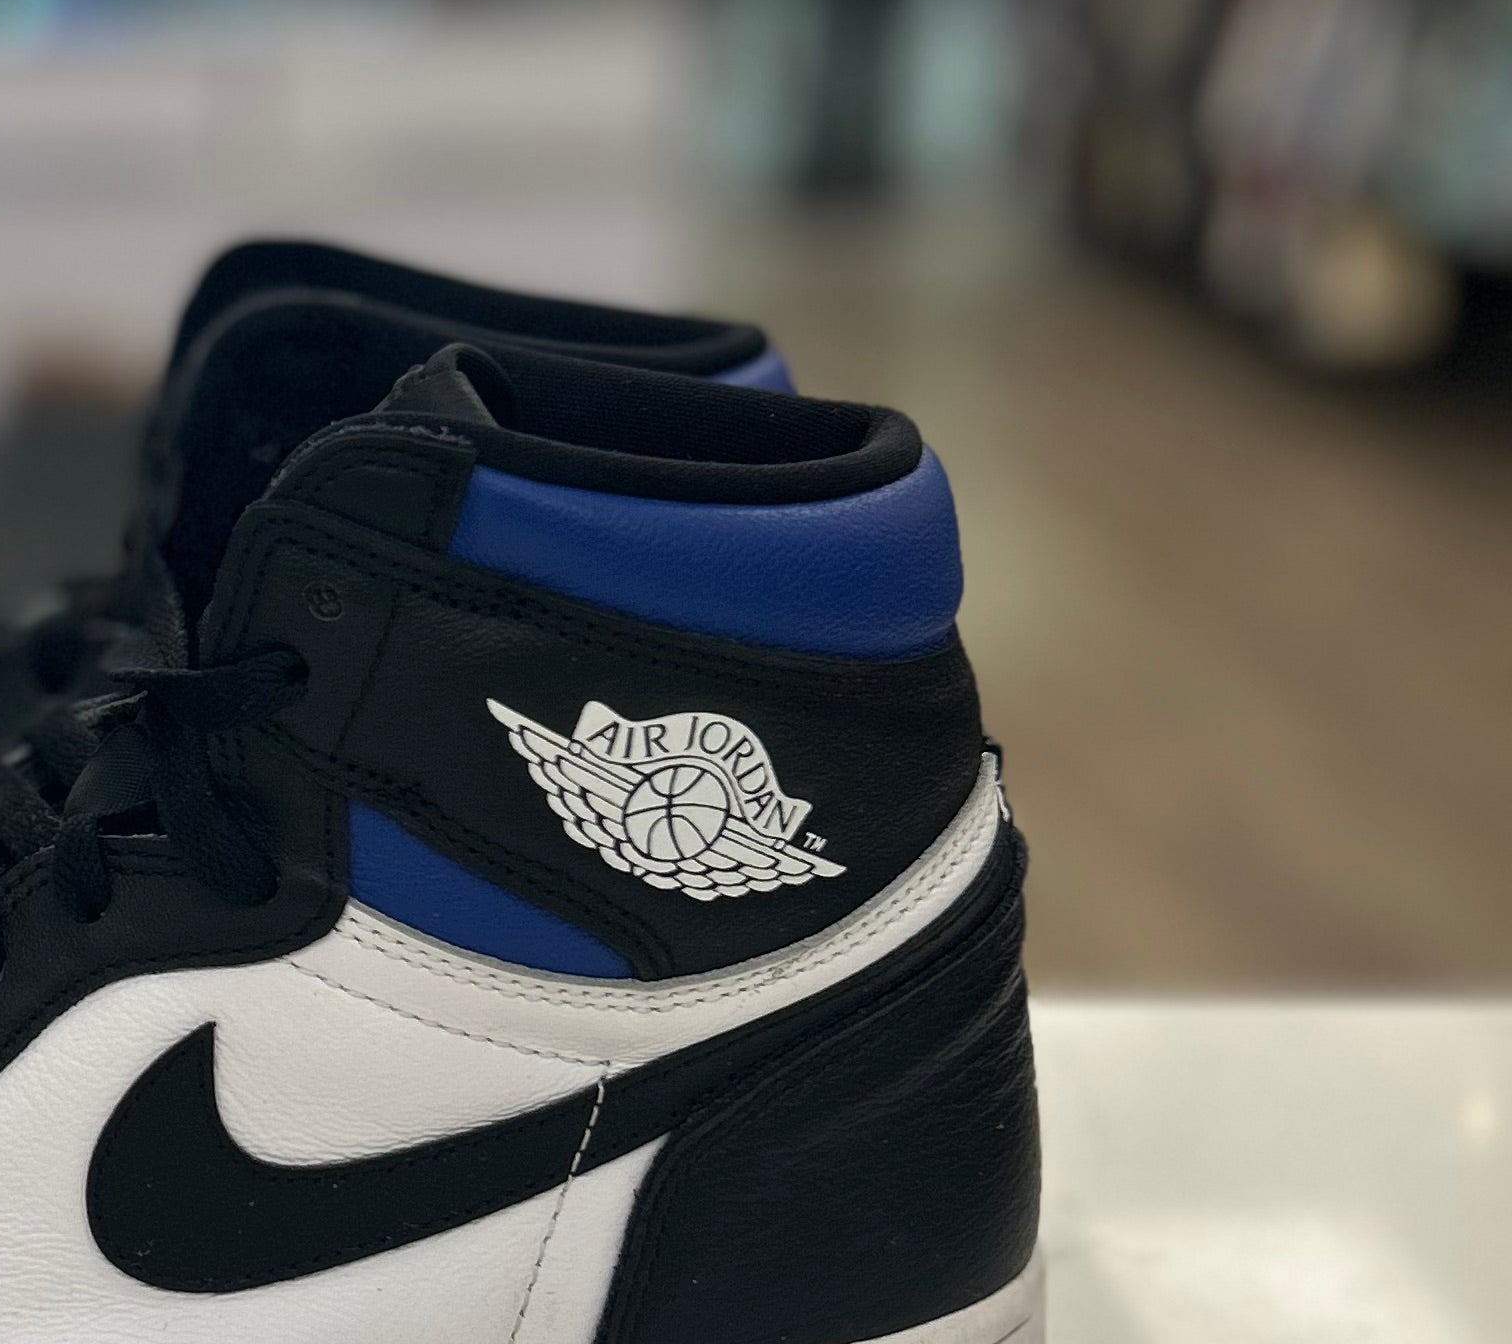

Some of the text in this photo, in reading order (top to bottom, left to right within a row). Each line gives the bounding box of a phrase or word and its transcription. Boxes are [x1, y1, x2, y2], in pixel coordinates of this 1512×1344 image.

[587, 716, 798, 833] AIR JORDAN
[803, 832, 827, 852] TM
